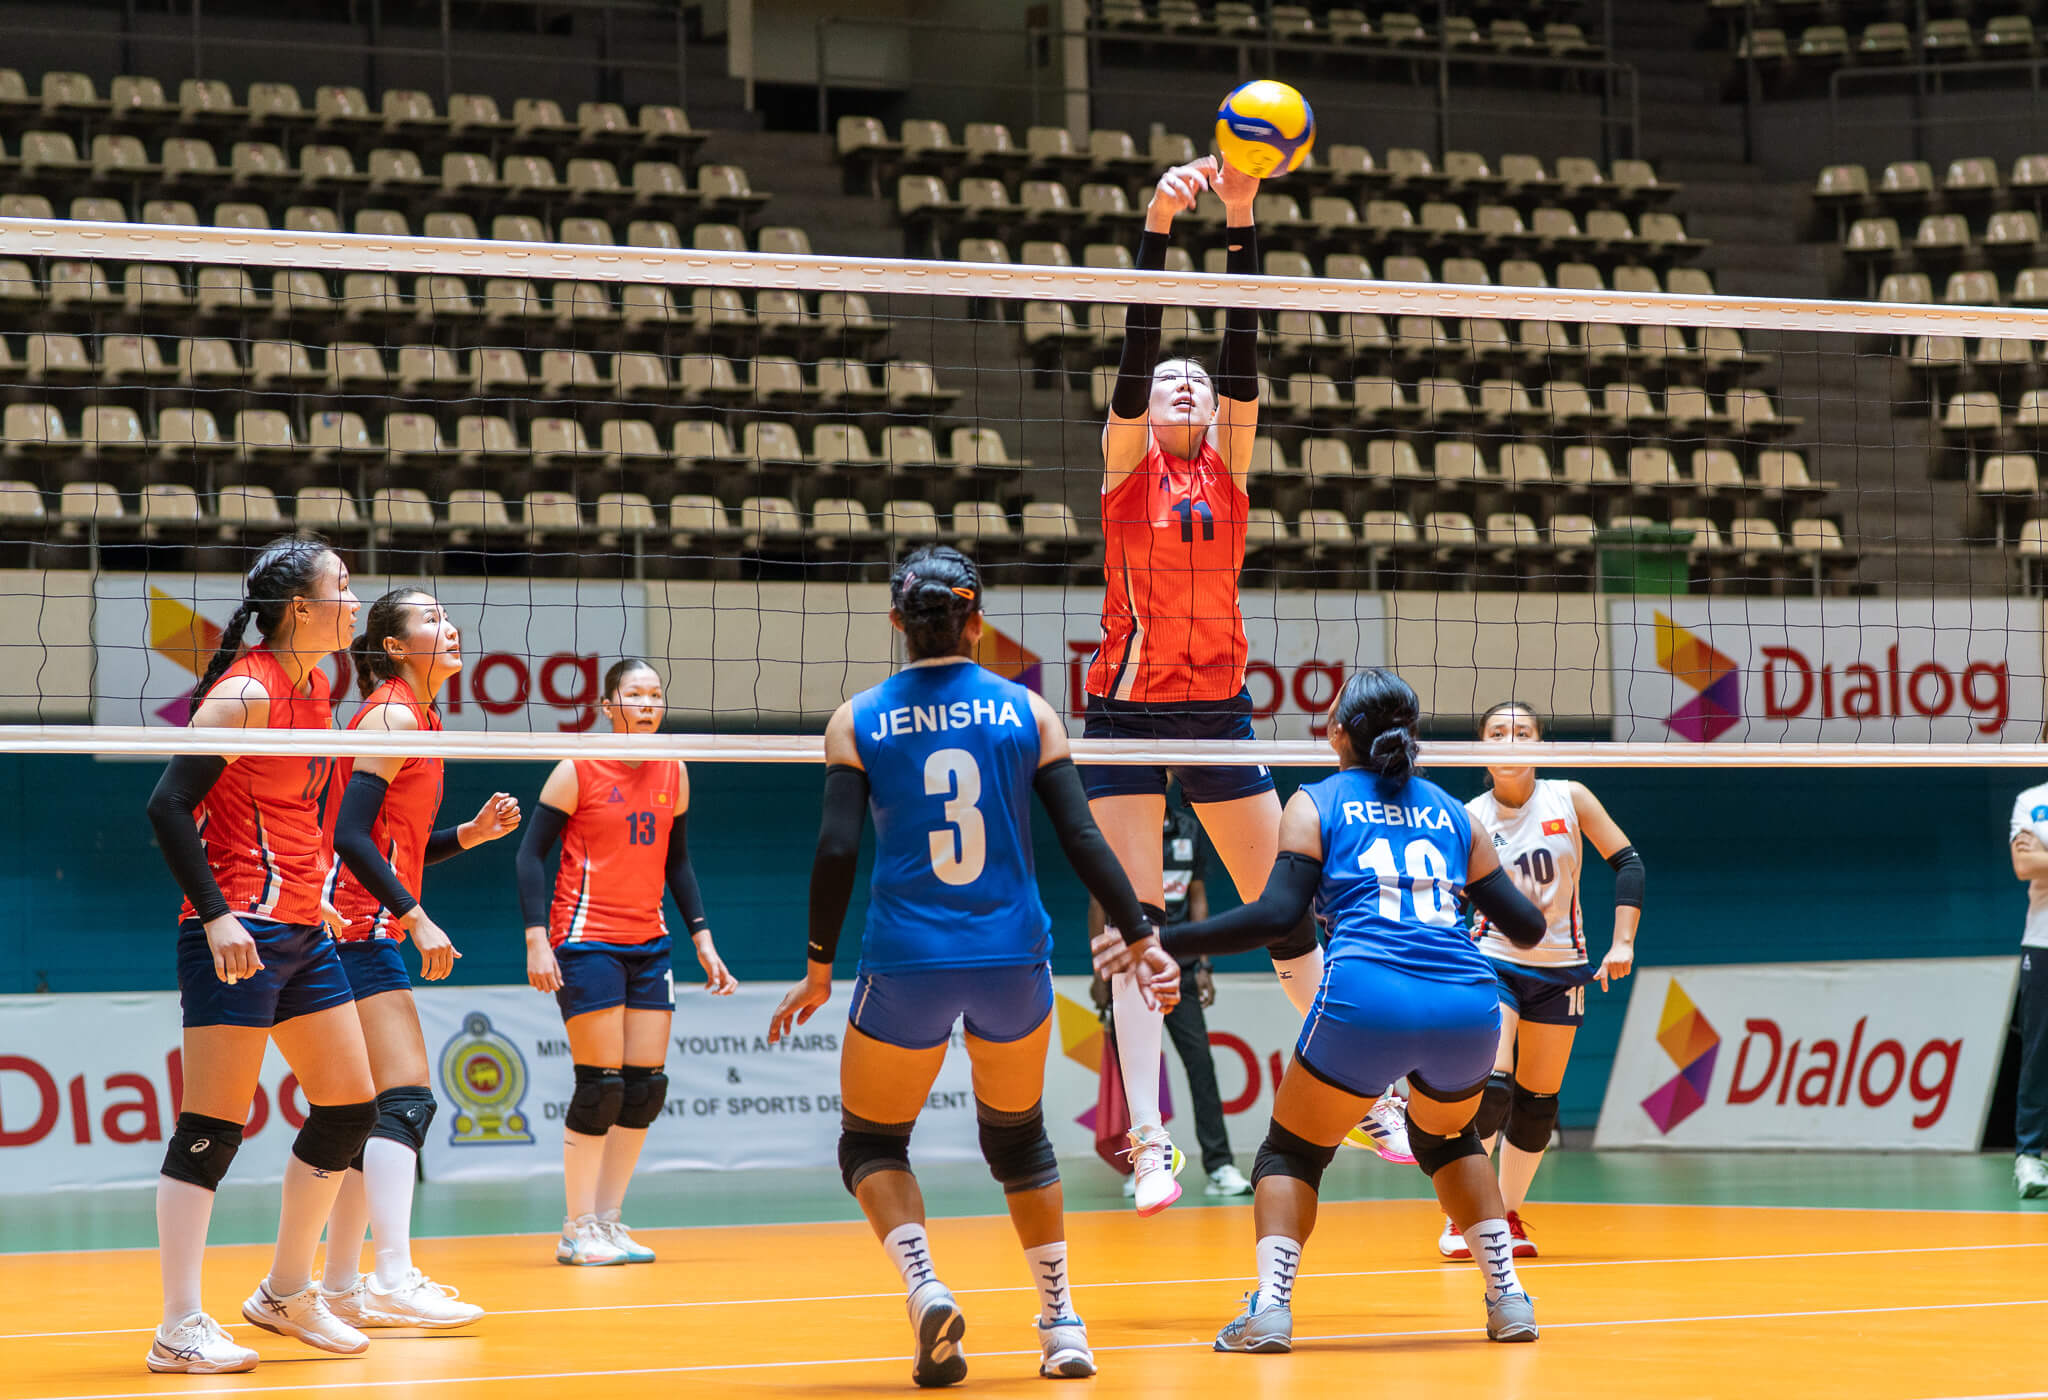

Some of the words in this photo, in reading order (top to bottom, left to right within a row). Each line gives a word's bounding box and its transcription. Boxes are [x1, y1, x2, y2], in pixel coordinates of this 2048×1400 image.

[1172, 498, 1214, 542] 11
[1760, 643, 2009, 734] Dialog
[871, 699, 1023, 741] JENISHA
[626, 811, 656, 845] 13
[923, 748, 986, 886] 3
[1342, 801, 1456, 834] REBIKA
[1357, 838, 1457, 928] 10
[1514, 848, 1554, 885] 10
[1565, 985, 1585, 1016] 10
[676, 1037, 746, 1054] YOUTH
[727, 1067, 740, 1083] &
[1725, 1015, 1964, 1130] Dialog
[694, 1099, 719, 1115] OF
[727, 1095, 811, 1114] SPORTS
